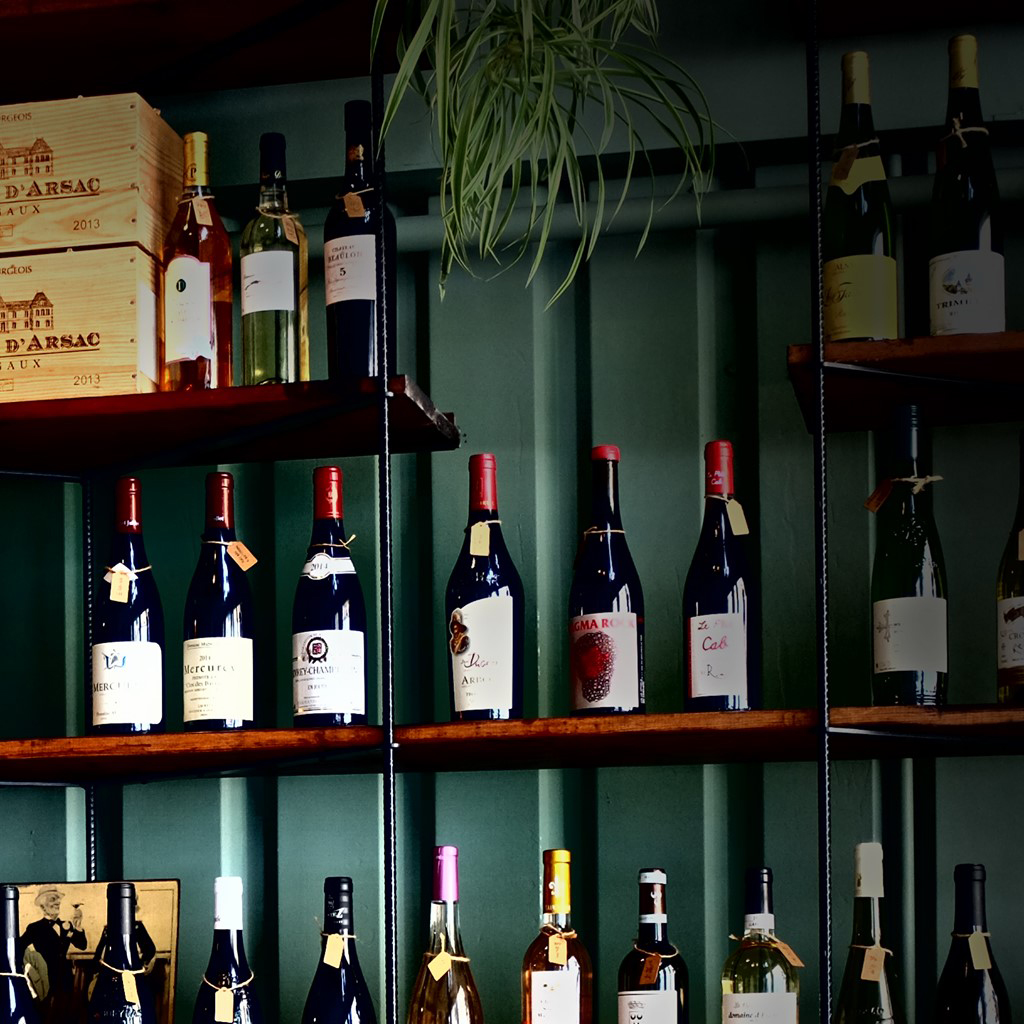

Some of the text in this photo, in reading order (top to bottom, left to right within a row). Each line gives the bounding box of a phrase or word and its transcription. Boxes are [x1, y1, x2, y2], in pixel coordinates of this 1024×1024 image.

[4, 177, 101, 199] D'ARSAC
[72, 219, 101, 231] 2013
[339, 267, 347, 277] 5
[5, 331, 101, 352] D'ARSAC
[73, 374, 101, 386] 2013
